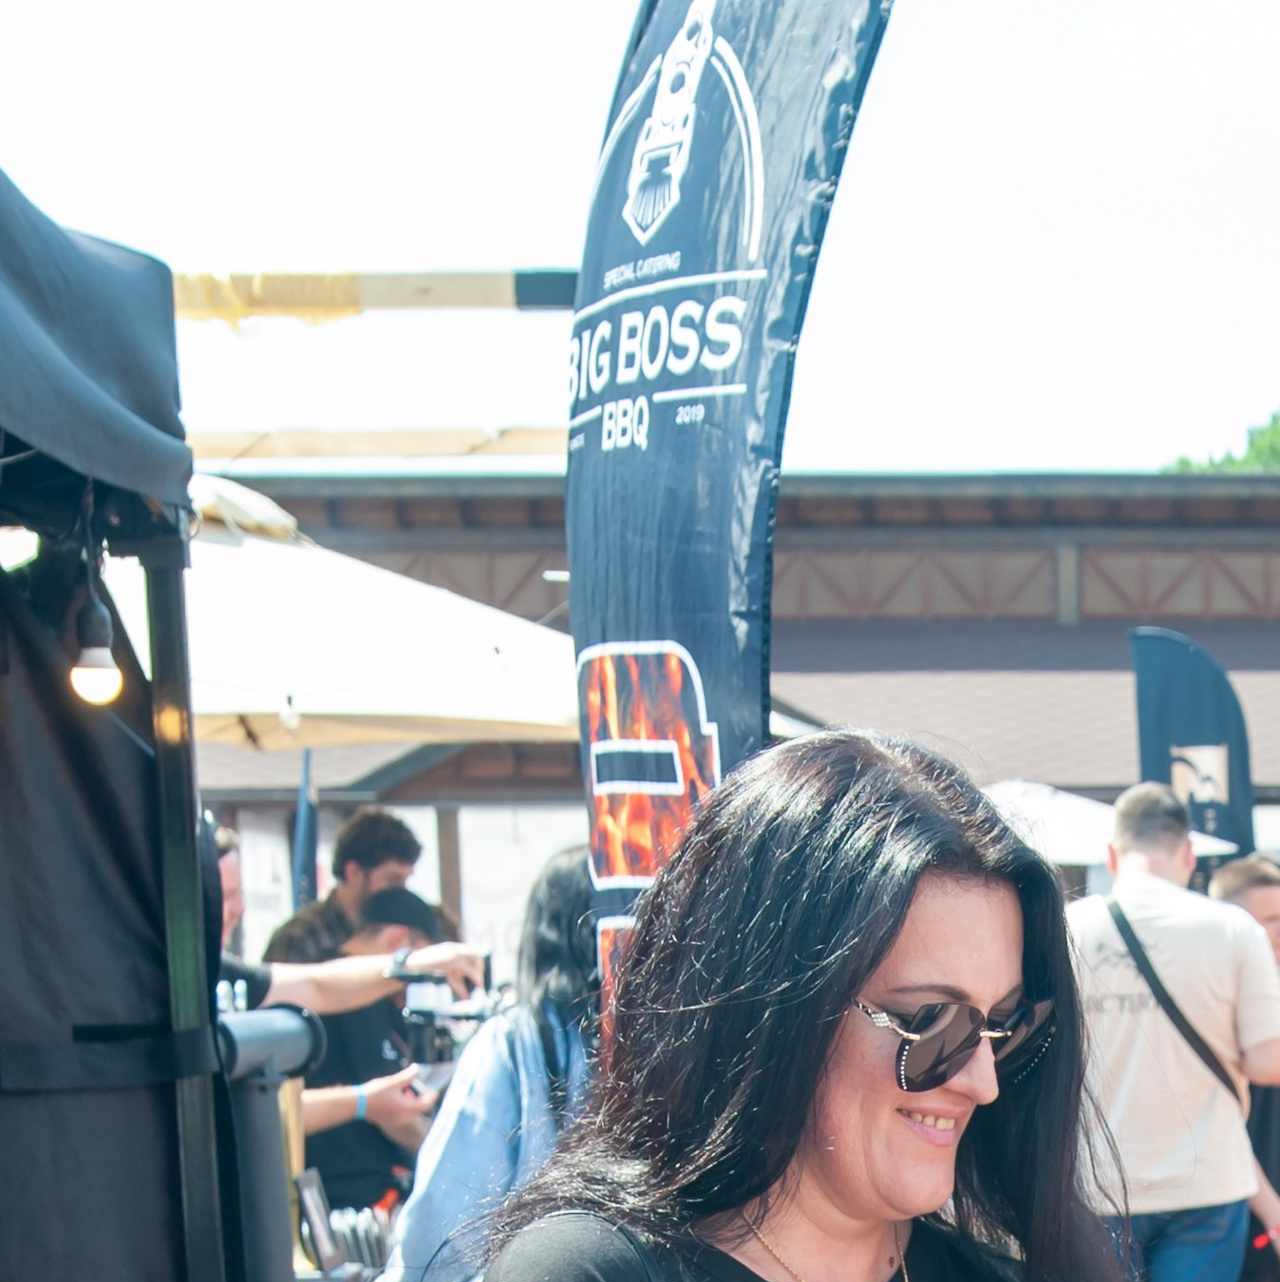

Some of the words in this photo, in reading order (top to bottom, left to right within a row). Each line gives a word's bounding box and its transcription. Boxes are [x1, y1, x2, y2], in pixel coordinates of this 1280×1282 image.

[615, 295, 748, 385] BOSS
[601, 395, 649, 451] BBQ
[675, 404, 705, 425] 2019
